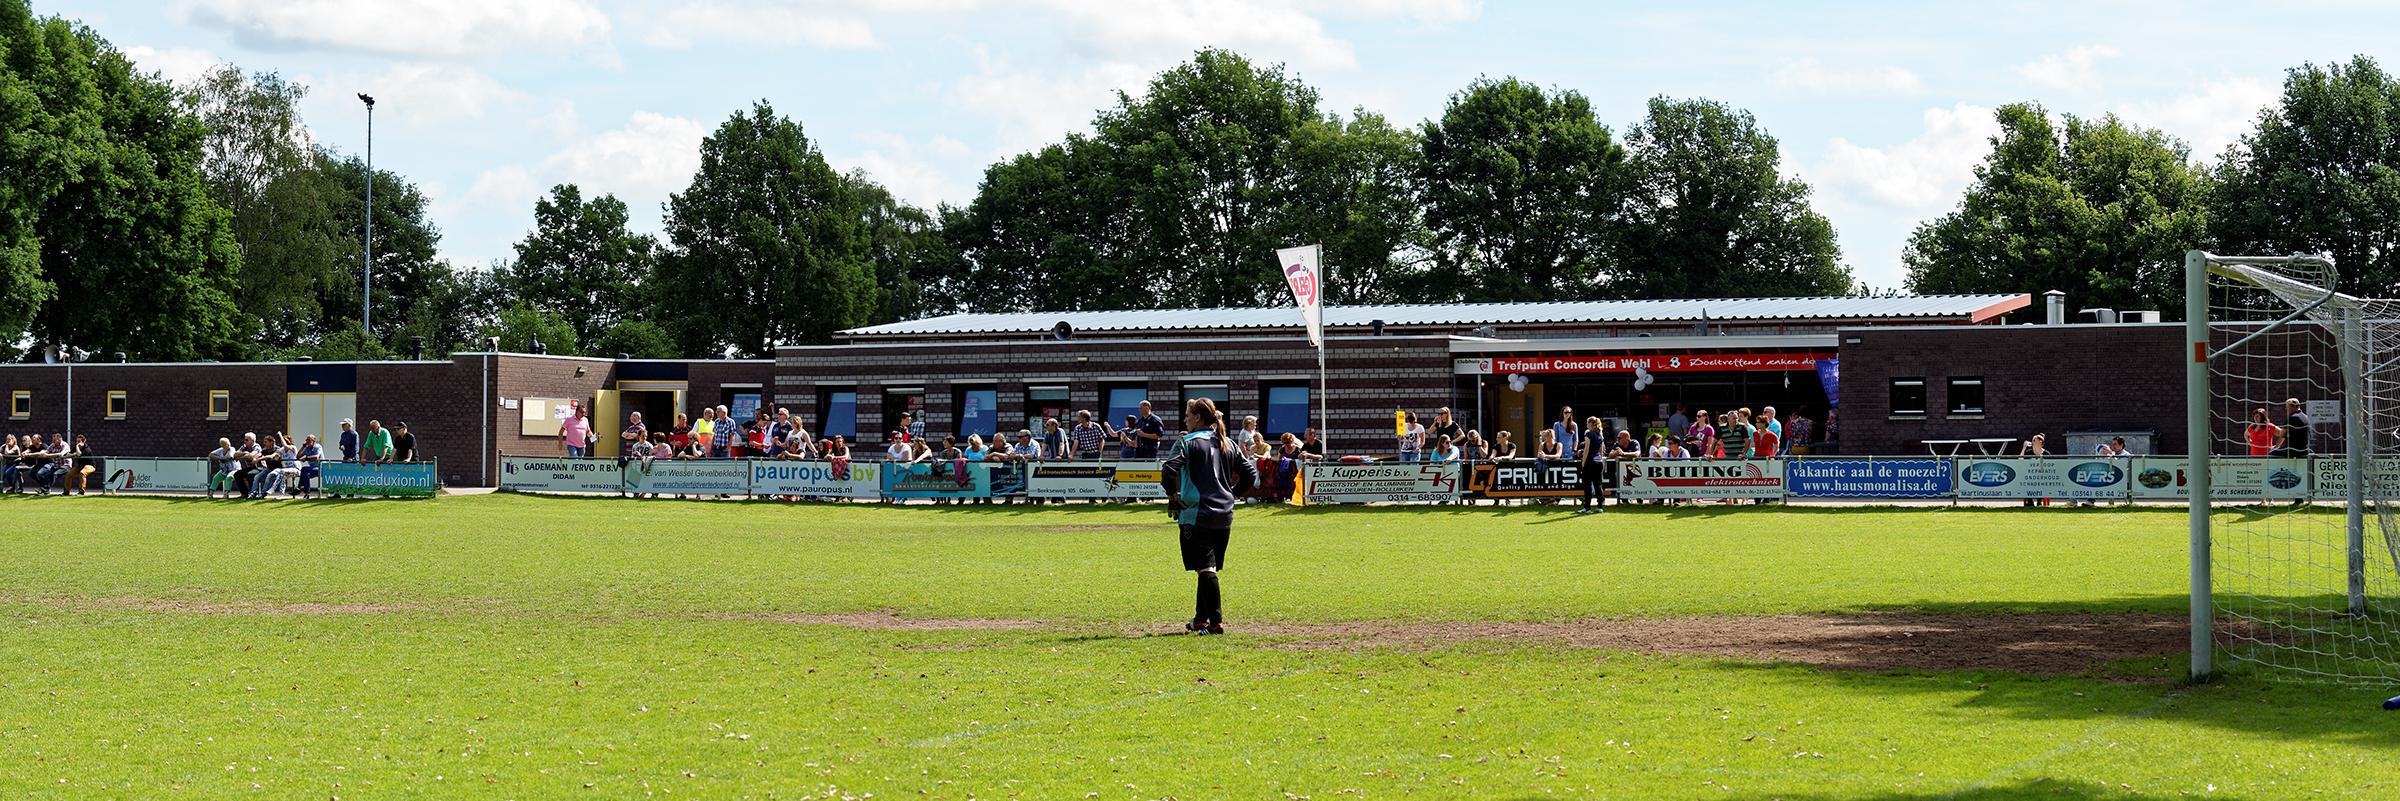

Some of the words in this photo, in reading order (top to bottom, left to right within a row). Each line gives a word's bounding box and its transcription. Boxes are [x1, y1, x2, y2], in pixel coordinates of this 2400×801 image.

[1497, 360, 1549, 371] Trefpunt
[1553, 359, 1616, 370] Concordia
[1621, 358, 1651, 369] Wehl
[1689, 358, 1762, 367] Doeltreffend
[524, 462, 568, 471] GADEMANN
[571, 463, 605, 472] ERVOR
[1313, 467, 1326, 478] B.
[1394, 469, 1411, 477] b.v.
[1647, 465, 1742, 478] BUITING
[1793, 466, 1846, 477] vakantie
[1850, 467, 1874, 478] aan
[1878, 466, 1893, 477] de
[1898, 466, 1948, 478] moezel?
[668, 469, 694, 477] Wessel
[695, 469, 748, 479] Gevelbekleding
[1969, 470, 2008, 482] EVERS
[2076, 470, 2116, 483] EVERS
[324, 473, 430, 488] www.preduxion.nl
[1704, 478, 1780, 486] elektrotechniek
[1802, 480, 1938, 491] www.hausmonalisa.de
[778, 485, 853, 494] www.pauropus.nl
